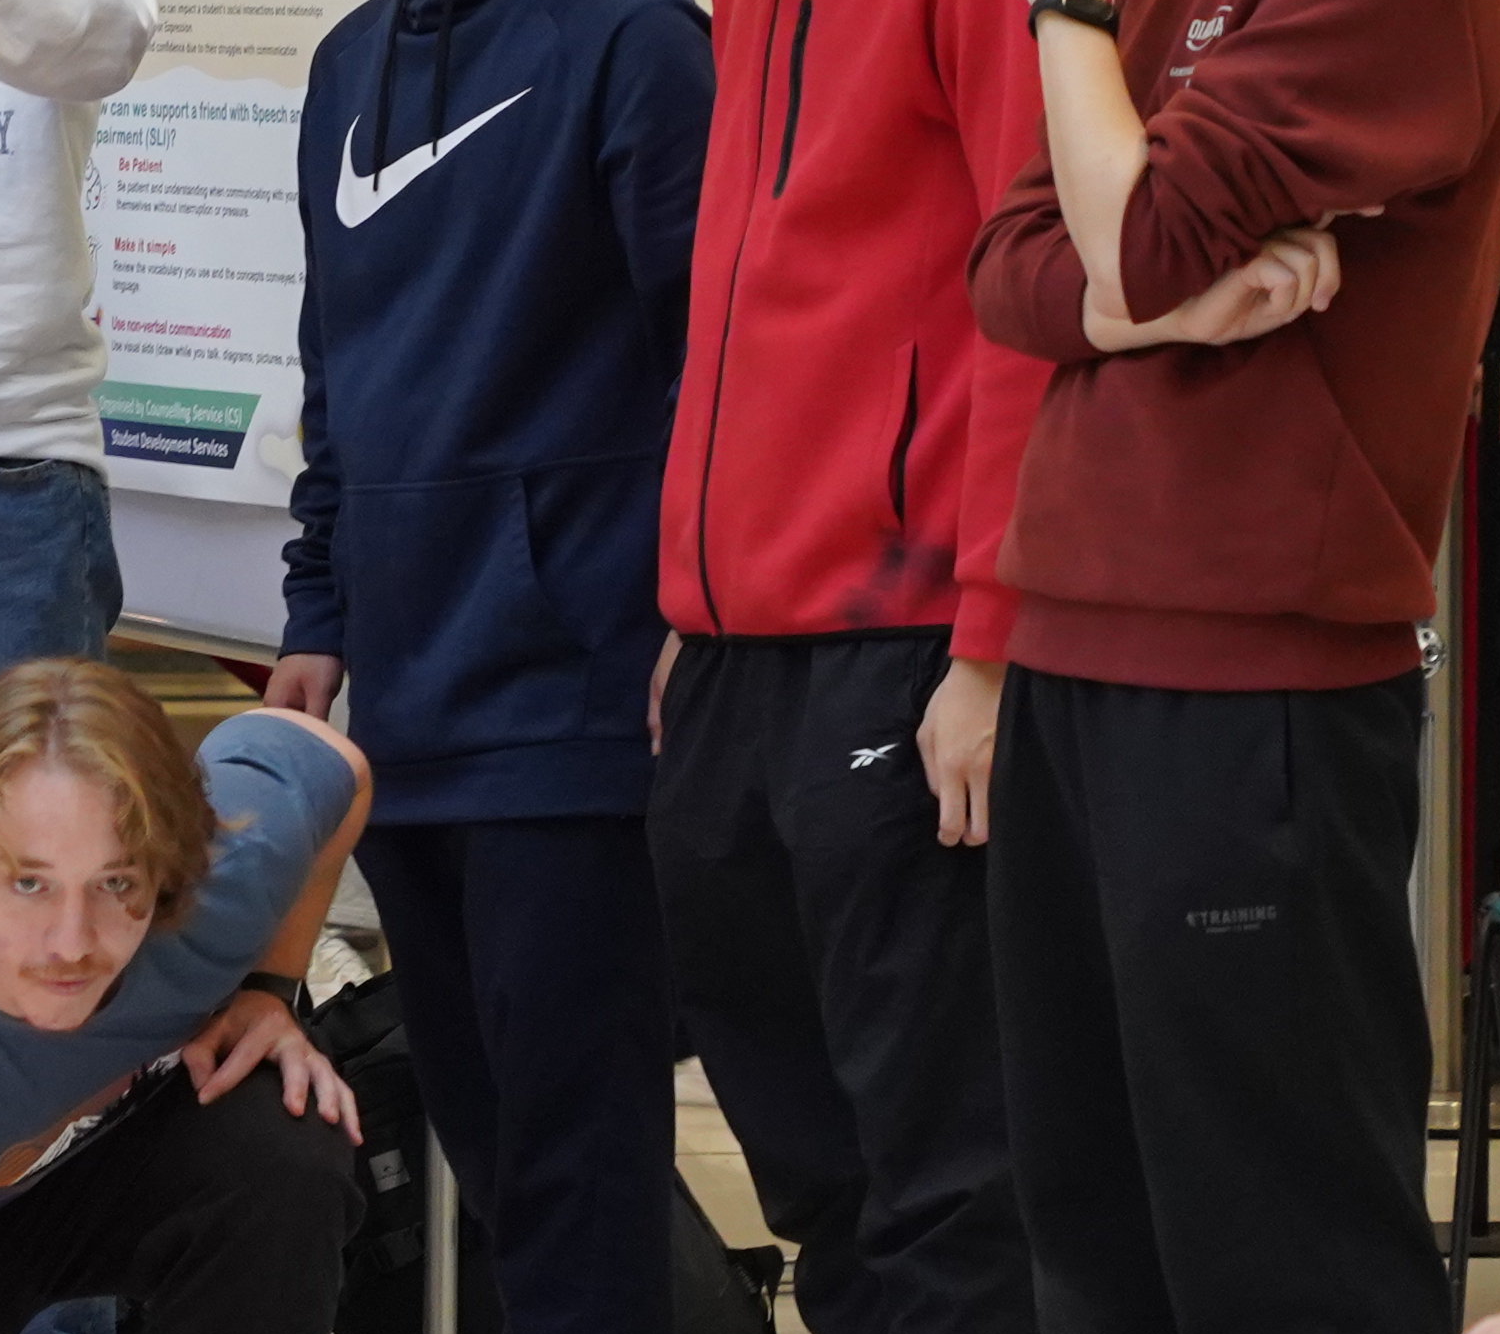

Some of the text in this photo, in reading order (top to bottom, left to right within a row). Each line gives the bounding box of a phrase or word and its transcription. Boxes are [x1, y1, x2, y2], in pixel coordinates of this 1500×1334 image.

[111, 428, 229, 459] Student Development Services
